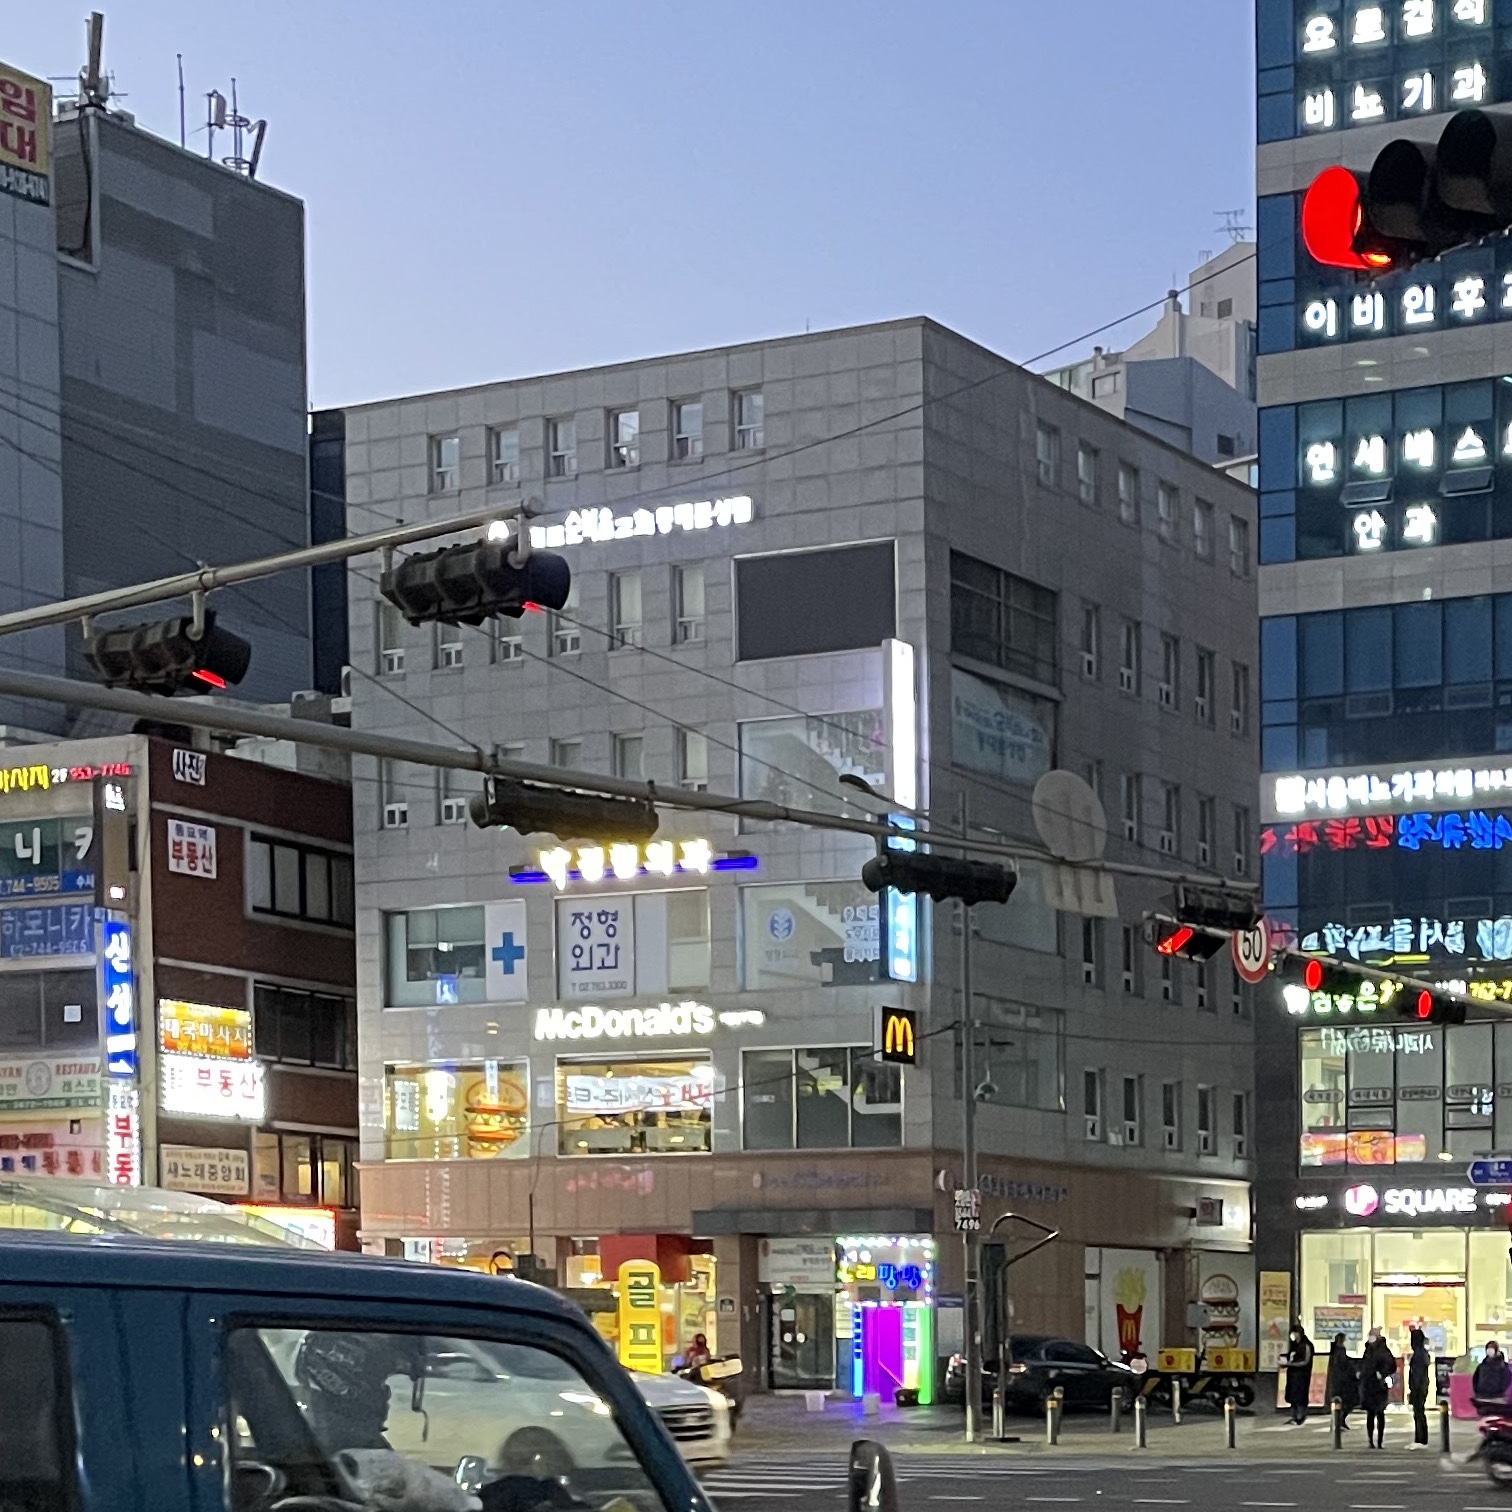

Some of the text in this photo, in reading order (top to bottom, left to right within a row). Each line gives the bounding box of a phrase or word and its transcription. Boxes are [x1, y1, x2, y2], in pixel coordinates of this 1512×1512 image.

[1304, 64, 1486, 127] 비뇨기과
[1353, 504, 1437, 549] 안과
[172, 839, 213, 874] 부동산
[2, 905, 91, 943] 하모니카
[571, 909, 619, 940] 정형
[571, 944, 620, 972] 외과
[1242, 925, 1262, 962] 50
[534, 1001, 715, 1040] McDonald's
[196, 1067, 257, 1099] 부동산
[1384, 1188, 1478, 1216] SQUARE
